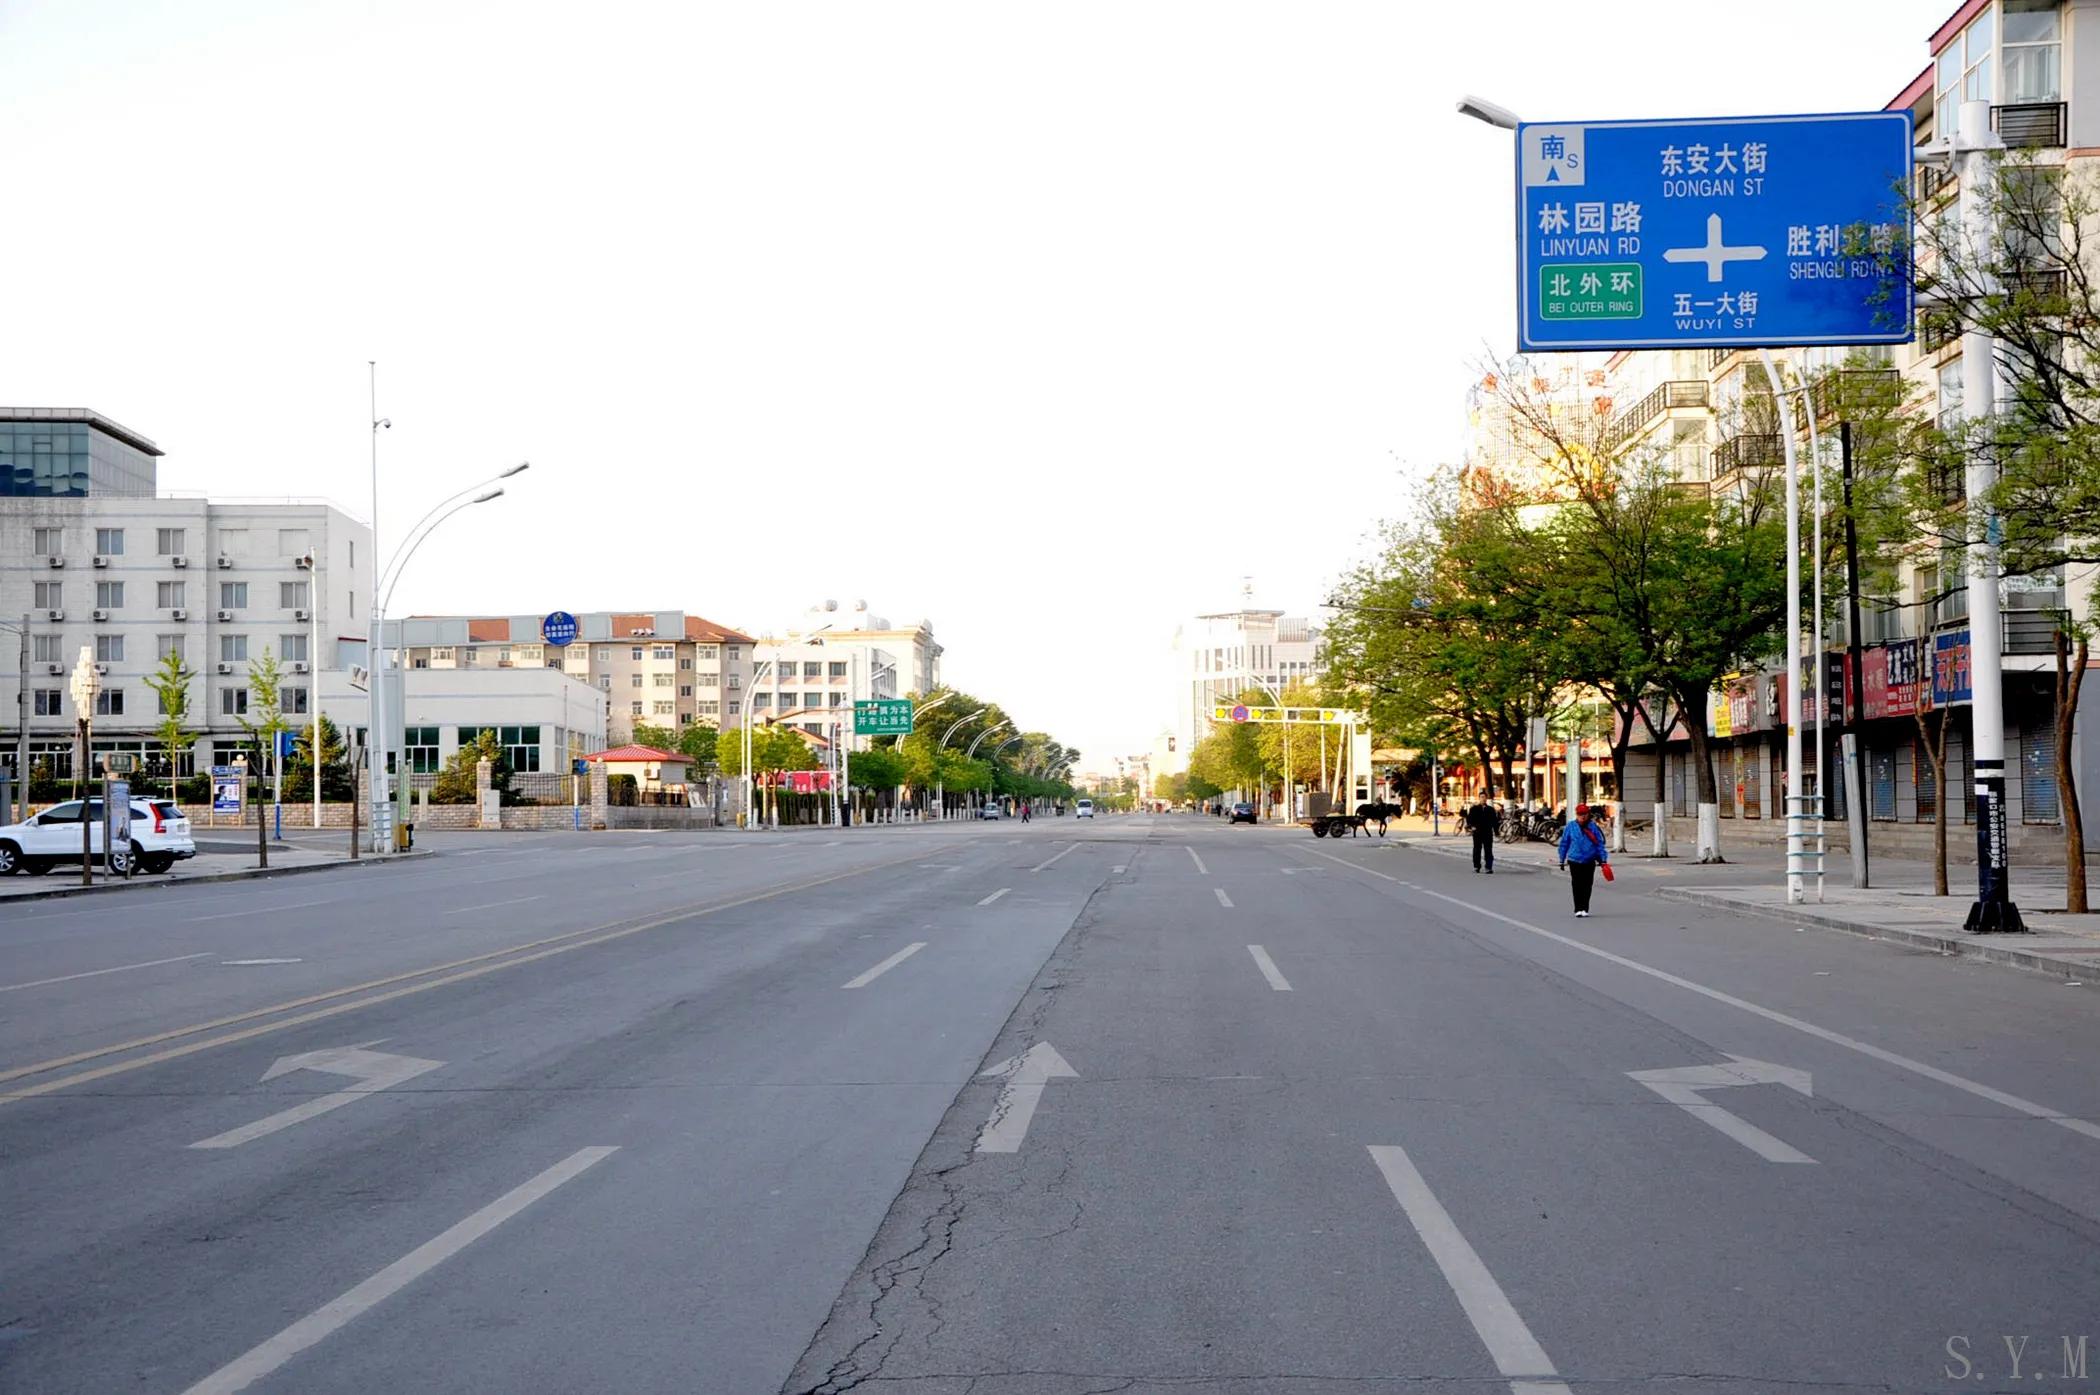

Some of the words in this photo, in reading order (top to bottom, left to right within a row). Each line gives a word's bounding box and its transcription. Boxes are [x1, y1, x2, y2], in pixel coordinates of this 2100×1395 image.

[1540, 134, 1566, 161] 南
[1566, 153, 1579, 168] S
[1660, 142, 1768, 177] 东安大街
[1663, 179, 1735, 198] DONGAN
[1743, 177, 1765, 196] ST
[1538, 201, 1643, 235] 林园路
[1541, 238, 1610, 257] LINYUAN
[1618, 236, 1641, 255] RD
[1549, 271, 1635, 297] 北外环
[1548, 302, 1565, 314] BEI
[1569, 301, 1604, 313] OUTER
[1608, 300, 1634, 312] RING
[1672, 290, 1759, 317] 五一大街
[1675, 318, 1722, 331] WUYI
[1732, 317, 1756, 329] ST
